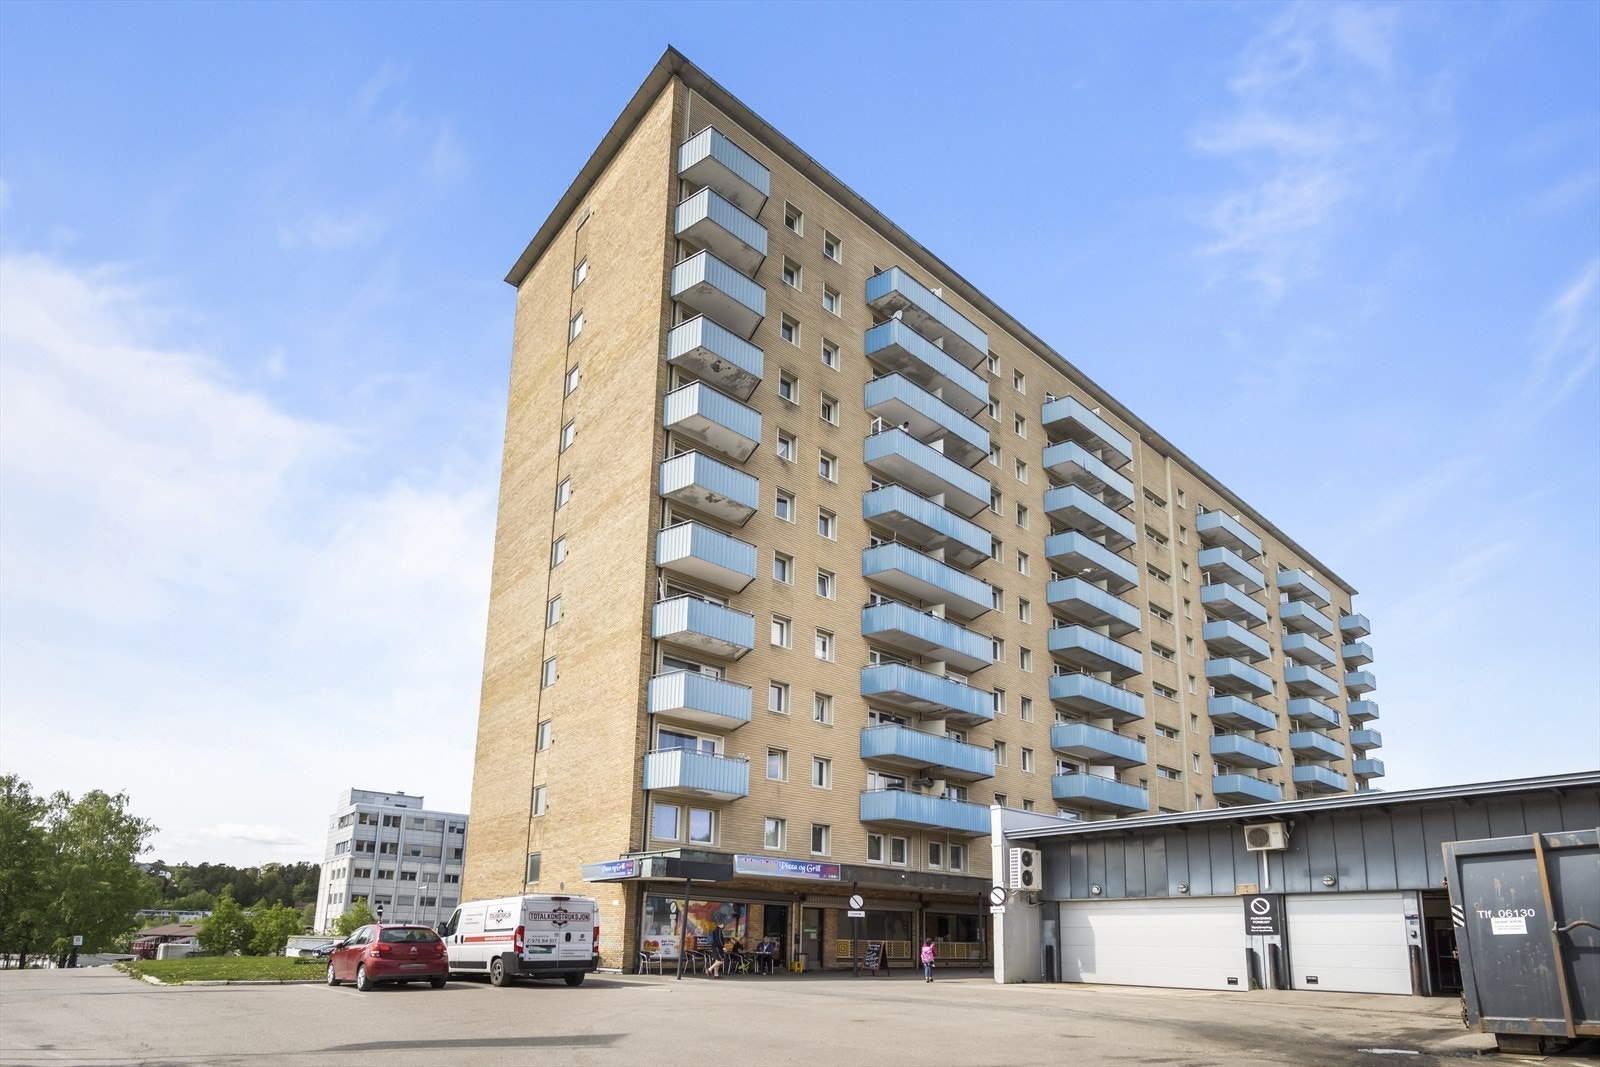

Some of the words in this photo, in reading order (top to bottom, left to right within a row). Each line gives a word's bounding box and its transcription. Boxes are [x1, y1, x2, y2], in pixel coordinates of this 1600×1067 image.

[601, 865, 611, 873] Pizza
[616, 863, 625, 872] Grill
[779, 861, 797, 870] Pizza
[799, 865, 806, 873] og
[806, 864, 821, 872] Grill
[1477, 910, 1495, 918] Tlf.
[1498, 908, 1535, 918] 06130
